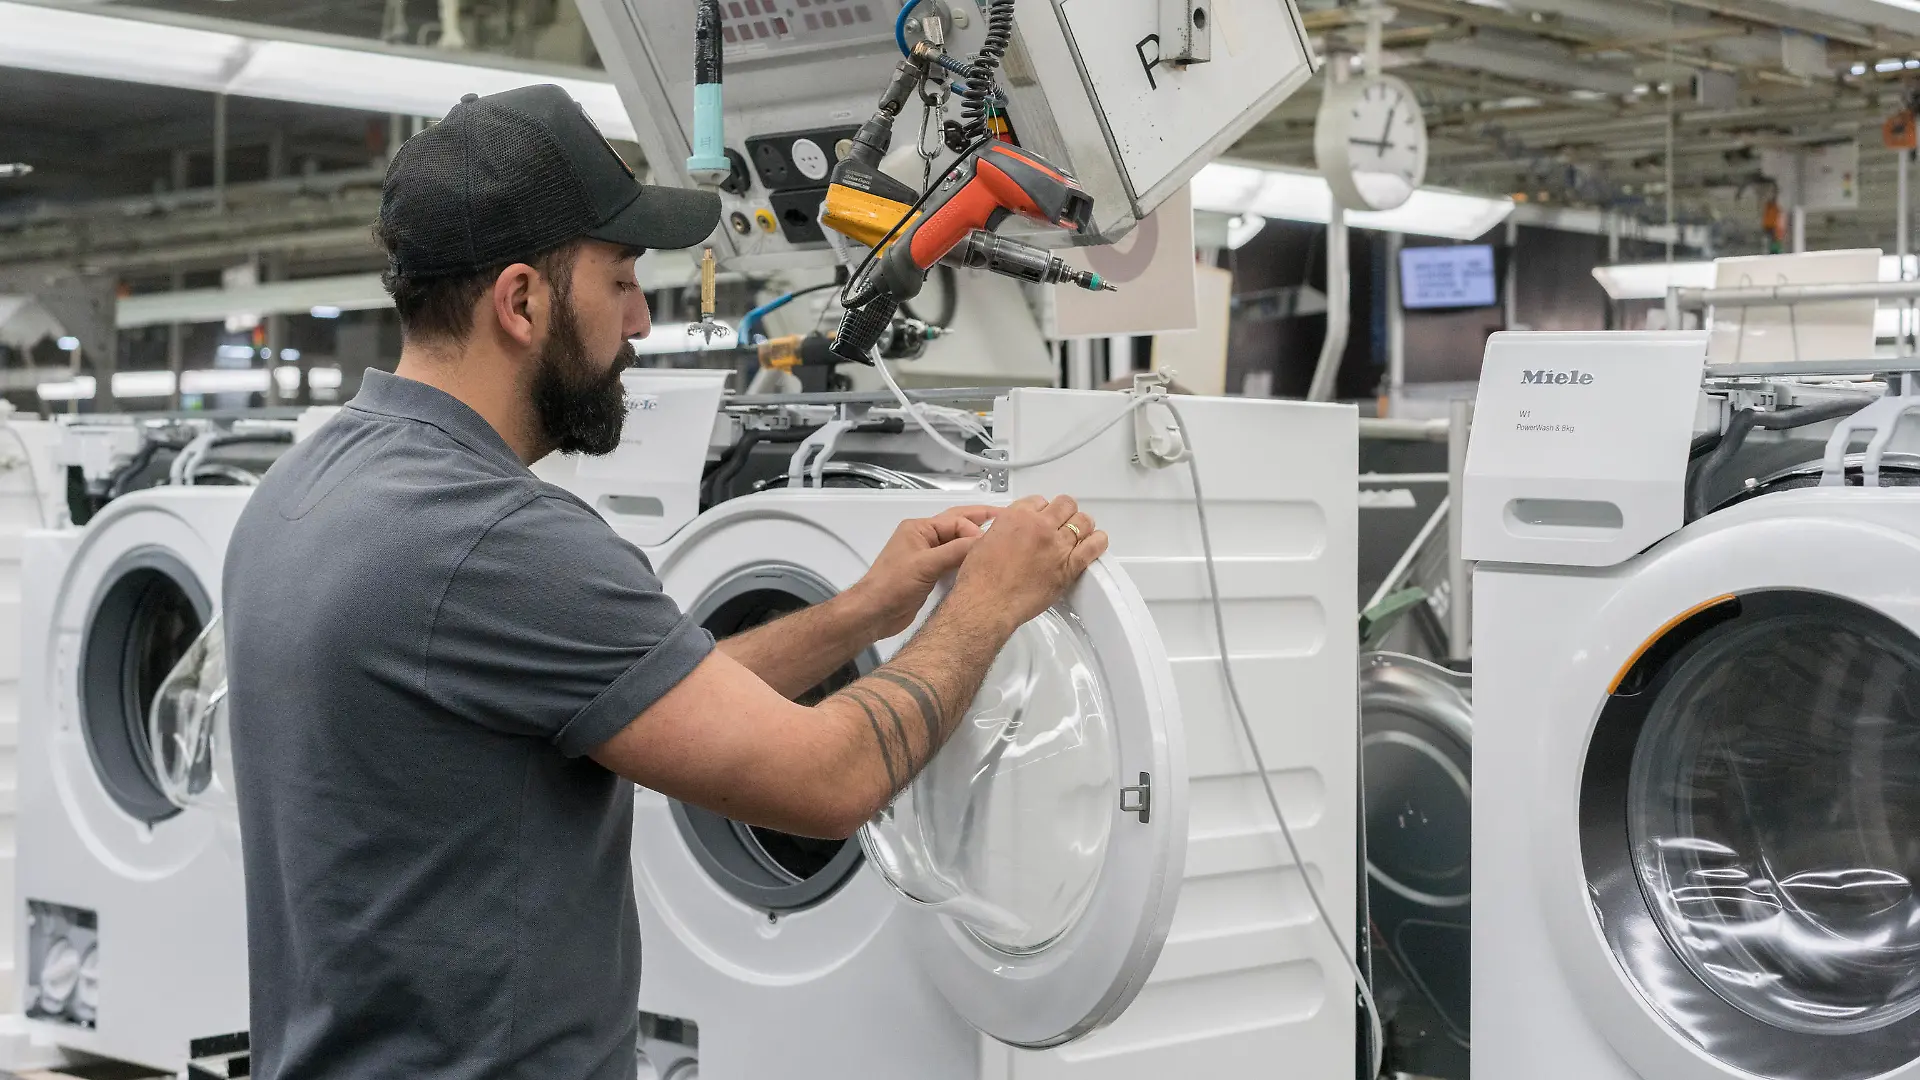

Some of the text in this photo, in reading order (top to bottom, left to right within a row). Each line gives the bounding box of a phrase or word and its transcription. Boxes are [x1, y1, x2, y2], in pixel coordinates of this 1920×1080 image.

[1521, 370, 1593, 385] Miele
[625, 399, 657, 411] iele
[1519, 410, 1531, 418] W1
[1516, 423, 1554, 432] PowerWash
